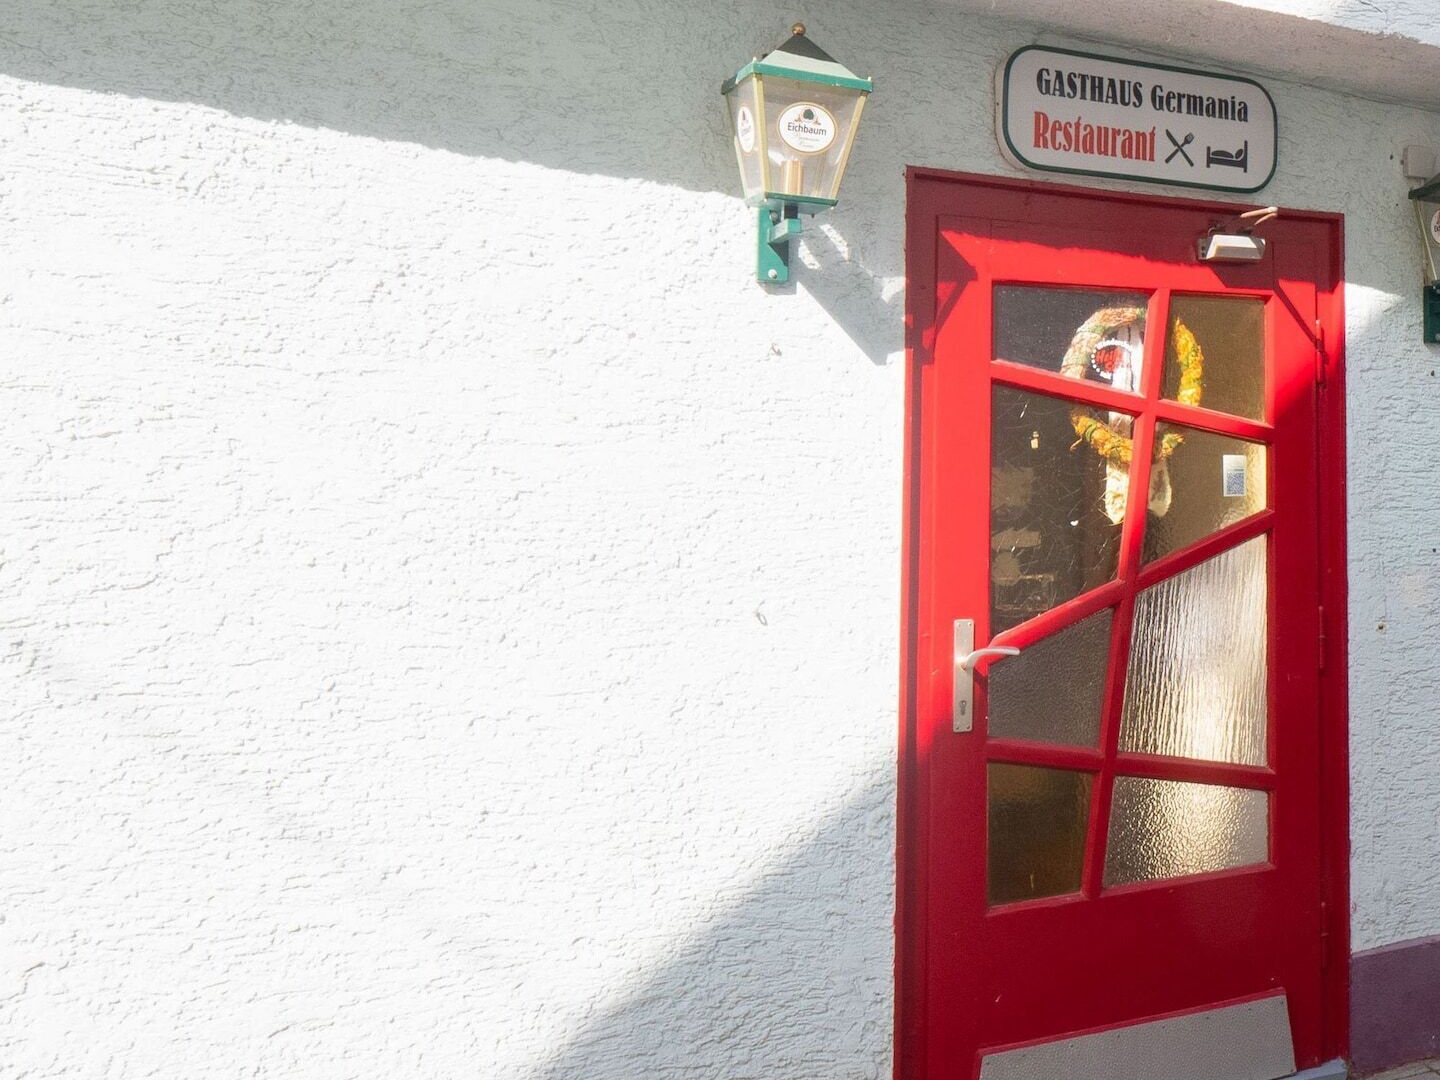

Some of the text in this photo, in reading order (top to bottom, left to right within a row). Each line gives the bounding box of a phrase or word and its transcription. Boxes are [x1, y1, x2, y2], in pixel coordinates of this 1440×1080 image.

[1036, 68, 1249, 122] GASTHAUS Germania
[787, 122, 827, 136] Eichbaum
[1033, 111, 1156, 162] Restaurant
